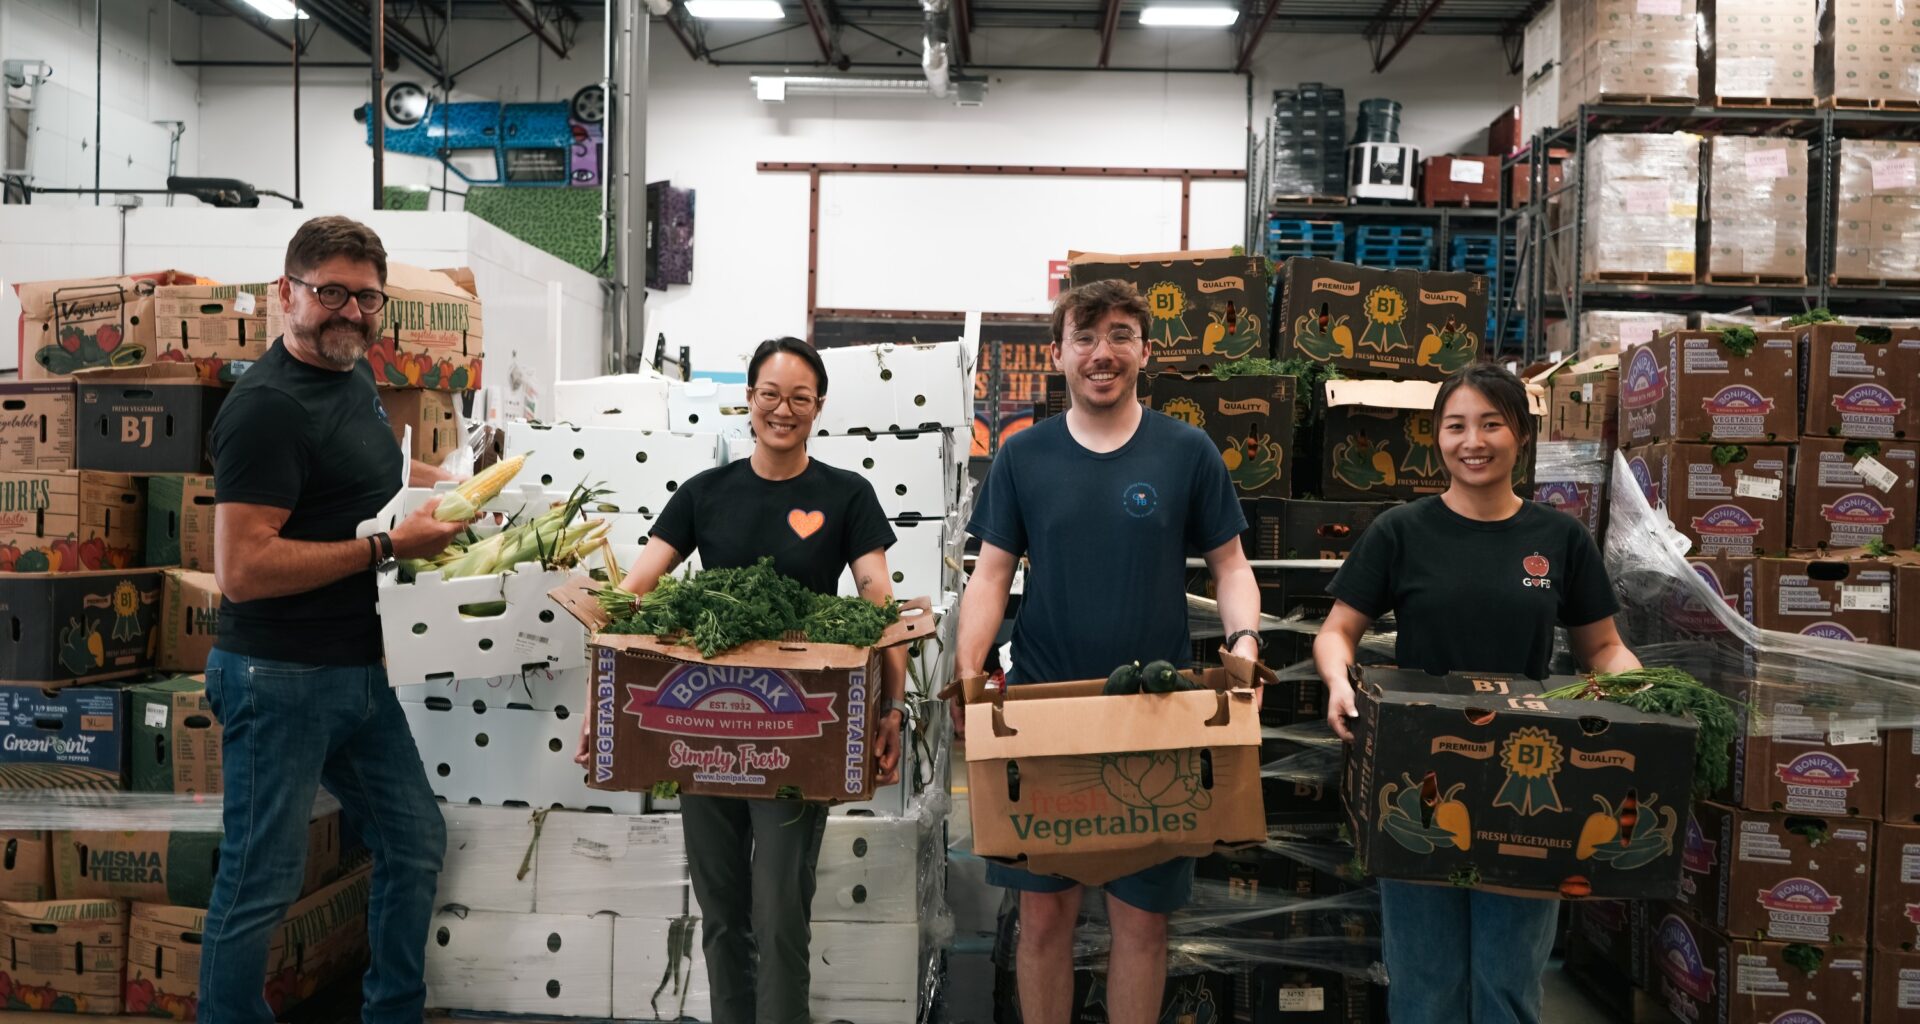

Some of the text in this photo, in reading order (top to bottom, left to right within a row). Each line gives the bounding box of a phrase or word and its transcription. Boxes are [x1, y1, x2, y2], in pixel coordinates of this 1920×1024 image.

[1202, 281, 1236, 289] QUALITY
[1317, 282, 1355, 292] PREMIUM
[1156, 293, 1175, 311] BJ
[1424, 293, 1459, 303] QUALITY
[62, 301, 120, 320] Vegetables
[1377, 298, 1395, 316] BJ
[382, 301, 470, 332] JAVIER ANDRES
[981, 343, 1053, 371] EALT
[1163, 348, 1201, 356] VEGETABLES
[1355, 352, 1415, 365] FRESH VEGETABLES
[1629, 356, 1656, 389] BONIPAK
[1719, 388, 1758, 405] BONIPAK
[1848, 389, 1889, 404] BONIPAK
[1223, 402, 1262, 411] QUALITY
[1418, 418, 1433, 435] B
[1714, 416, 1764, 424] VEGETABLES
[1843, 415, 1895, 424] VEGETABLES
[121, 415, 154, 448] BJ
[0, 479, 50, 513] DRES
[1838, 499, 1878, 513] BONIPAK
[1708, 510, 1748, 524] BONIPAK
[1832, 524, 1883, 534] VEGETABLES
[1702, 536, 1753, 544] VEGETABLES
[121, 592, 131, 607] BJ
[196, 607, 220, 620] MIS
[671, 666, 789, 709] BONIPAK
[1472, 679, 1510, 695] BJ
[36, 704, 46, 713] 1/9
[46, 705, 68, 713] BUSHEL
[709, 701, 752, 711] EST. 1932
[597, 648, 615, 783] VEGETABLES
[665, 714, 795, 730] GROWN WITH PRIDE
[845, 670, 866, 794] EGETABLES
[3, 734, 96, 754] GreenPoint
[1439, 742, 1487, 753] PREMIUM
[669, 740, 790, 774] Simply Fresh
[1517, 744, 1545, 769] BJ
[1579, 754, 1626, 765] QUALITY
[1795, 758, 1840, 775] BONIPAK
[694, 772, 766, 785] www.bonipak.com
[1788, 787, 1846, 797] VEGETABLES
[1031, 788, 1109, 815] fresh
[1009, 807, 1197, 845] Vegetables
[1476, 830, 1573, 849] FRESH VEGETABLES
[91, 850, 162, 868] MISMA
[89, 867, 164, 883] TIERRA
[1777, 883, 1824, 901] BONIPAK
[44, 902, 118, 921] JAVIER ANDRES
[1771, 913, 1828, 924] VEGETABLES
